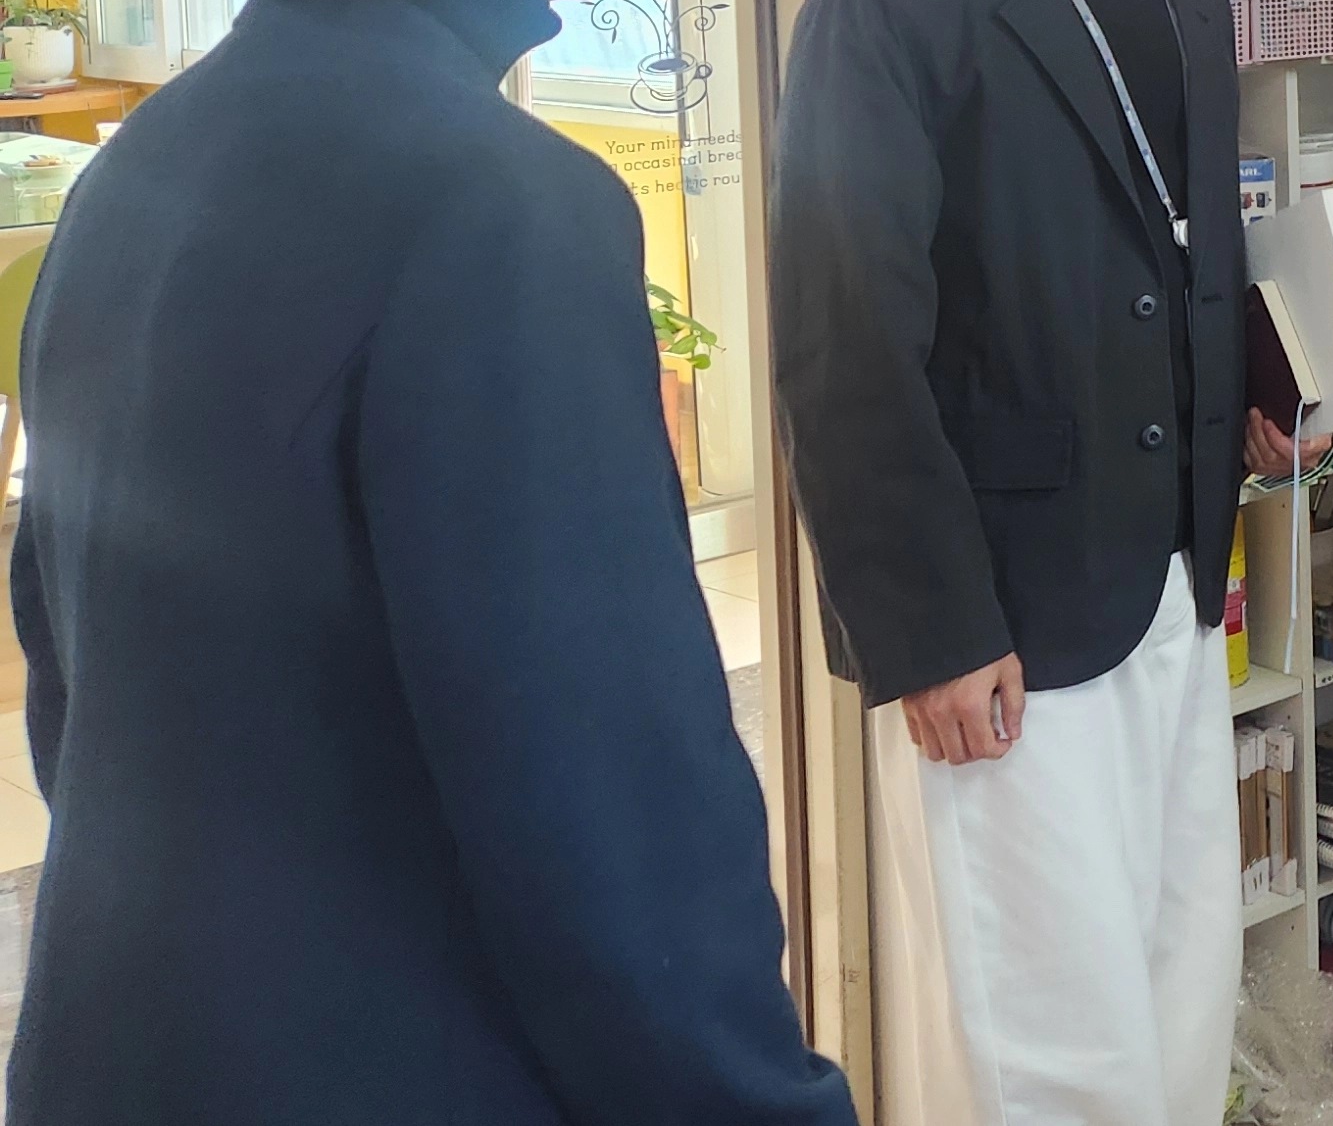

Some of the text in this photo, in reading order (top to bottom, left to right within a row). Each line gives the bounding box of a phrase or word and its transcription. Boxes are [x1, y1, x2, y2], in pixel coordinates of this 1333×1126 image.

[605, 130, 742, 154] Your mind needs
[655, 174, 708, 193] hectic
